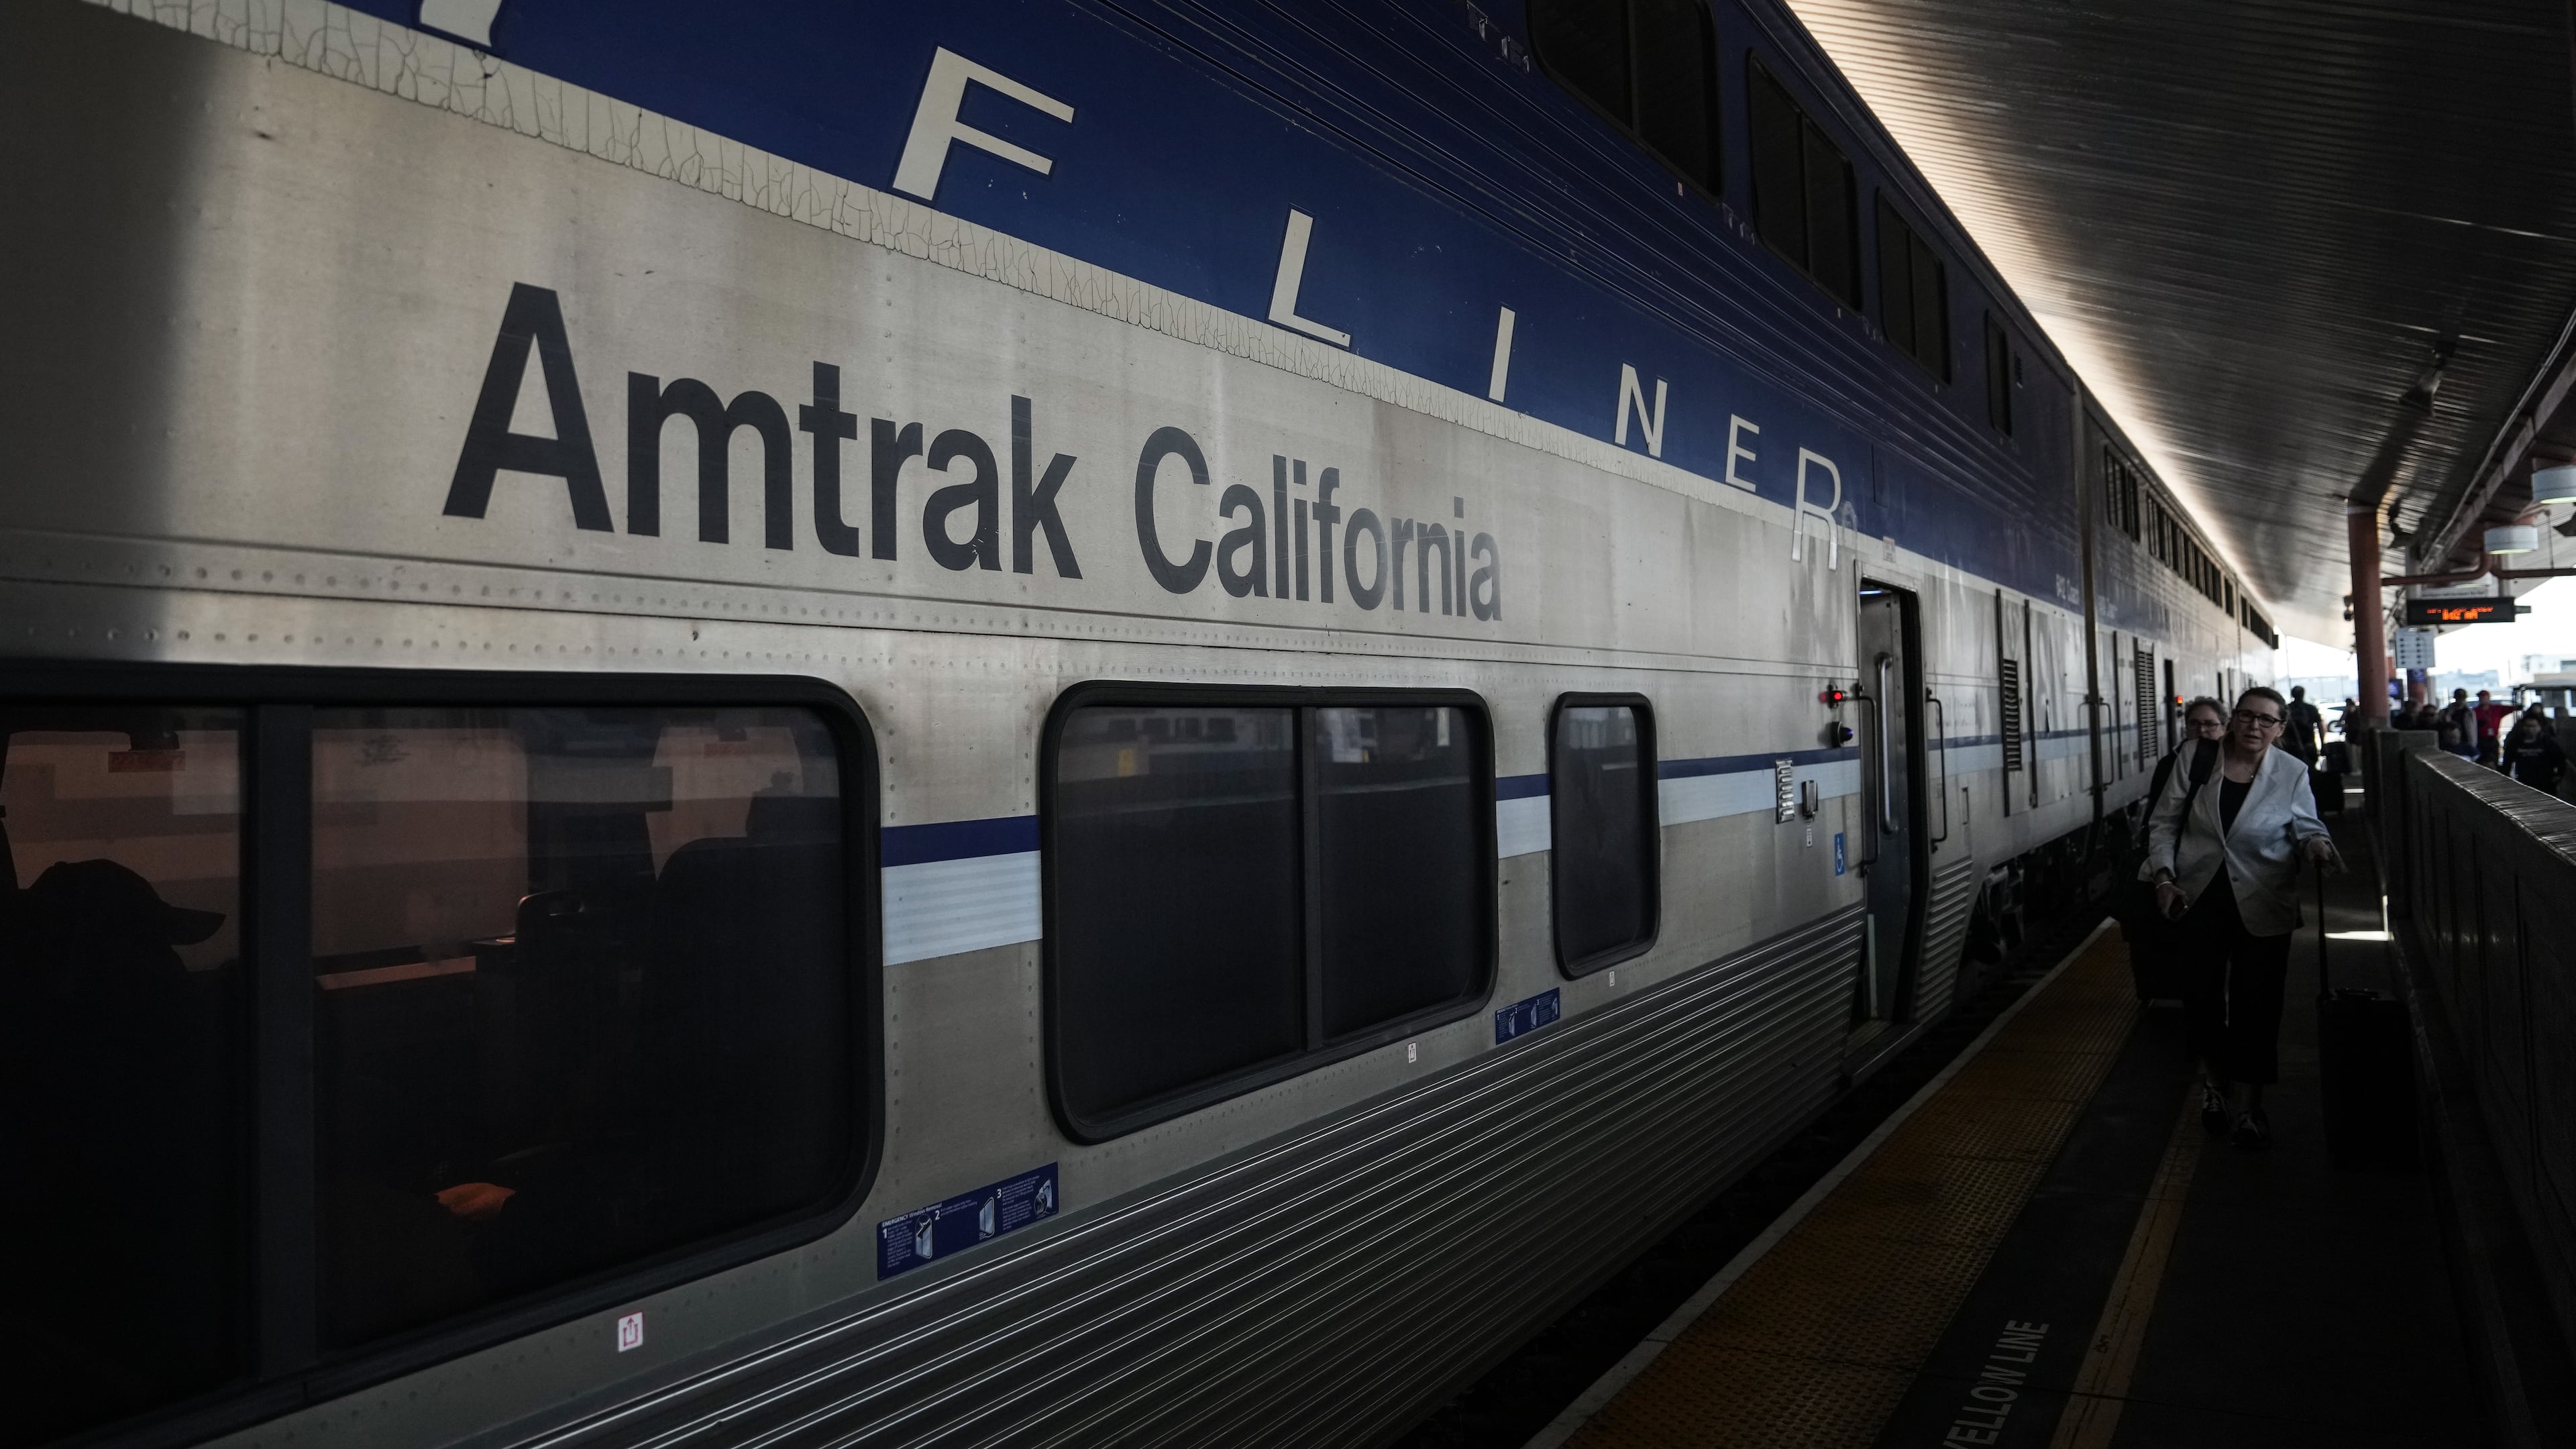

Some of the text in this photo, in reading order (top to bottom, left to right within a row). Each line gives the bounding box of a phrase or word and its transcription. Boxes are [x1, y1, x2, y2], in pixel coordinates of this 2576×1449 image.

[443, 282, 1503, 622] Amtrak California
[996, 1188, 1002, 1199] 3
[881, 1212, 909, 1228] EMERGENCY
[909, 1208, 926, 1218] Window
[926, 1201, 943, 1212] Removal
[934, 1210, 941, 1221] 2
[882, 1228, 888, 1239] 1
[1989, 1320, 2051, 1364] LINE
